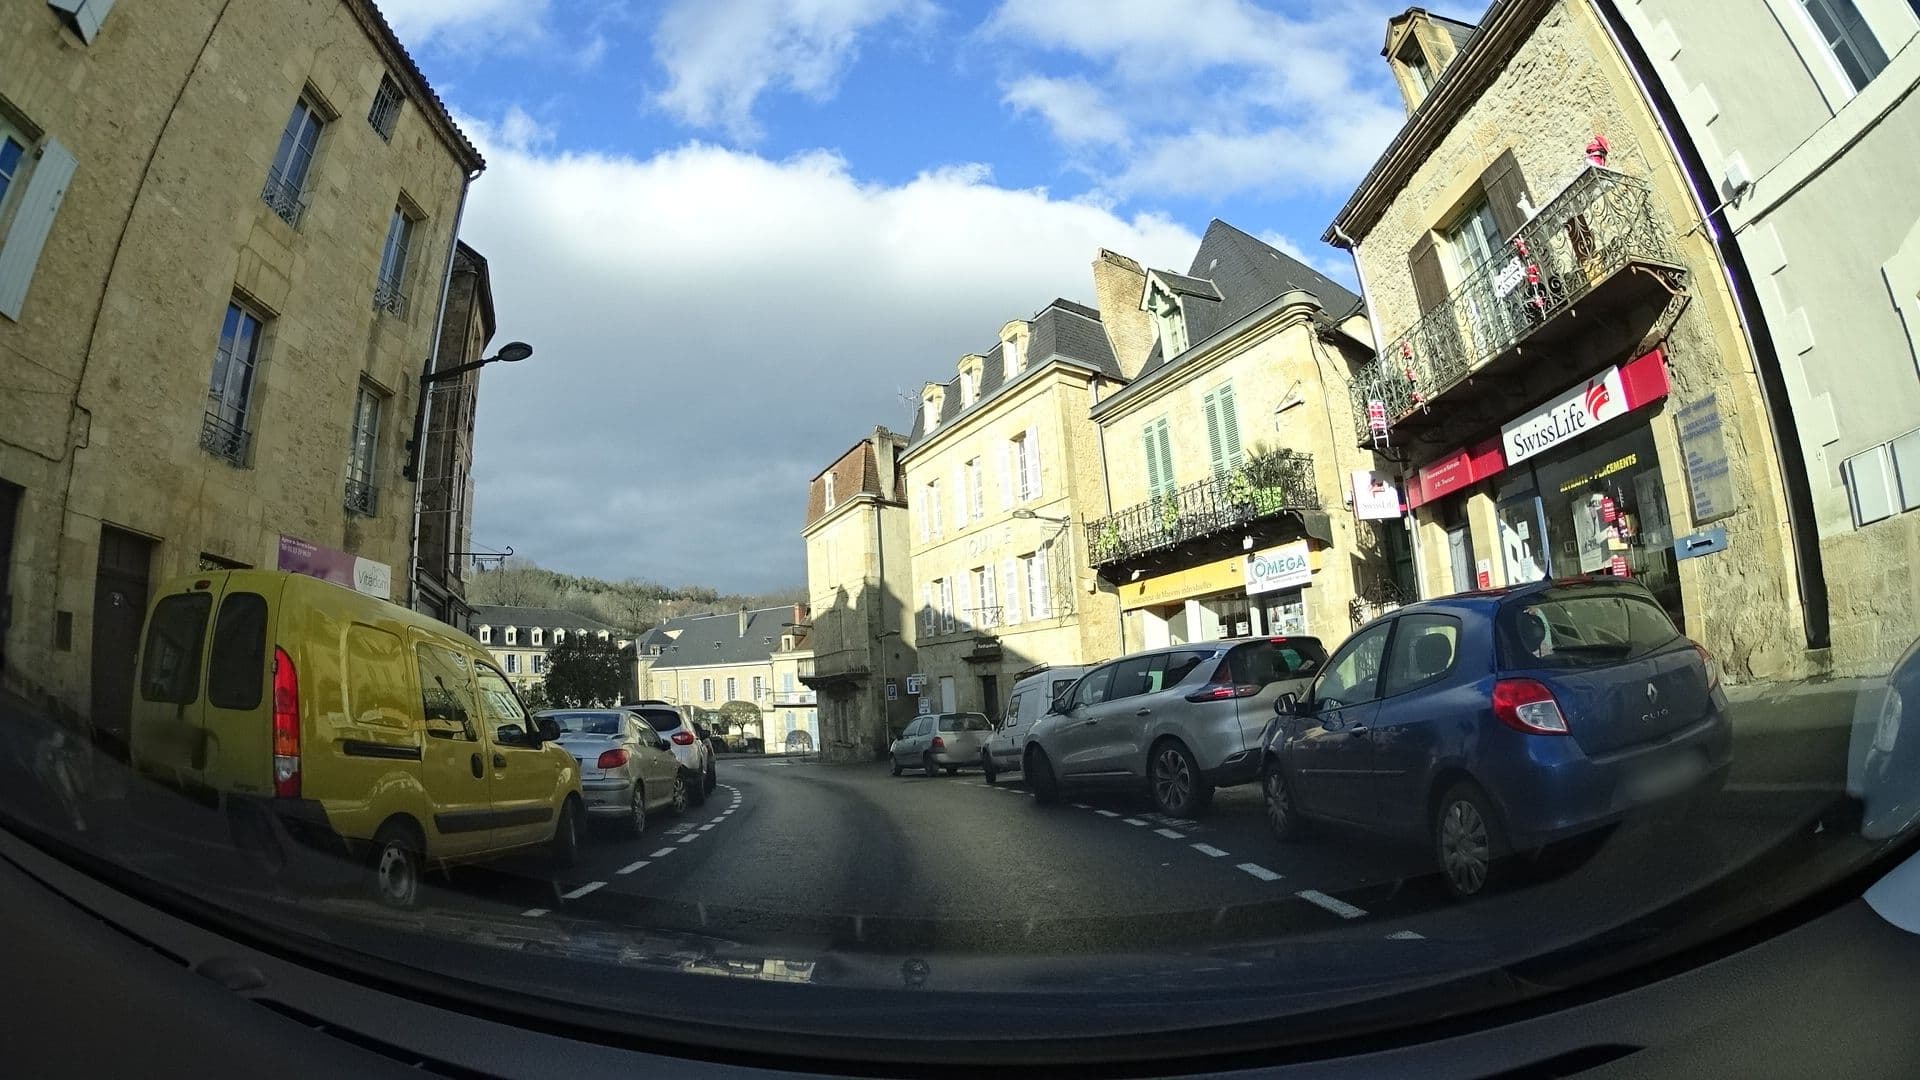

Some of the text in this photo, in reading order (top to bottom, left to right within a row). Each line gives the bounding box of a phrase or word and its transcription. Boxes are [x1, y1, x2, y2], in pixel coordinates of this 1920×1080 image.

[1513, 403, 1586, 457] SwissLife
[1255, 555, 1306, 577] OMEGA
[1641, 708, 1669, 721] CLIO
